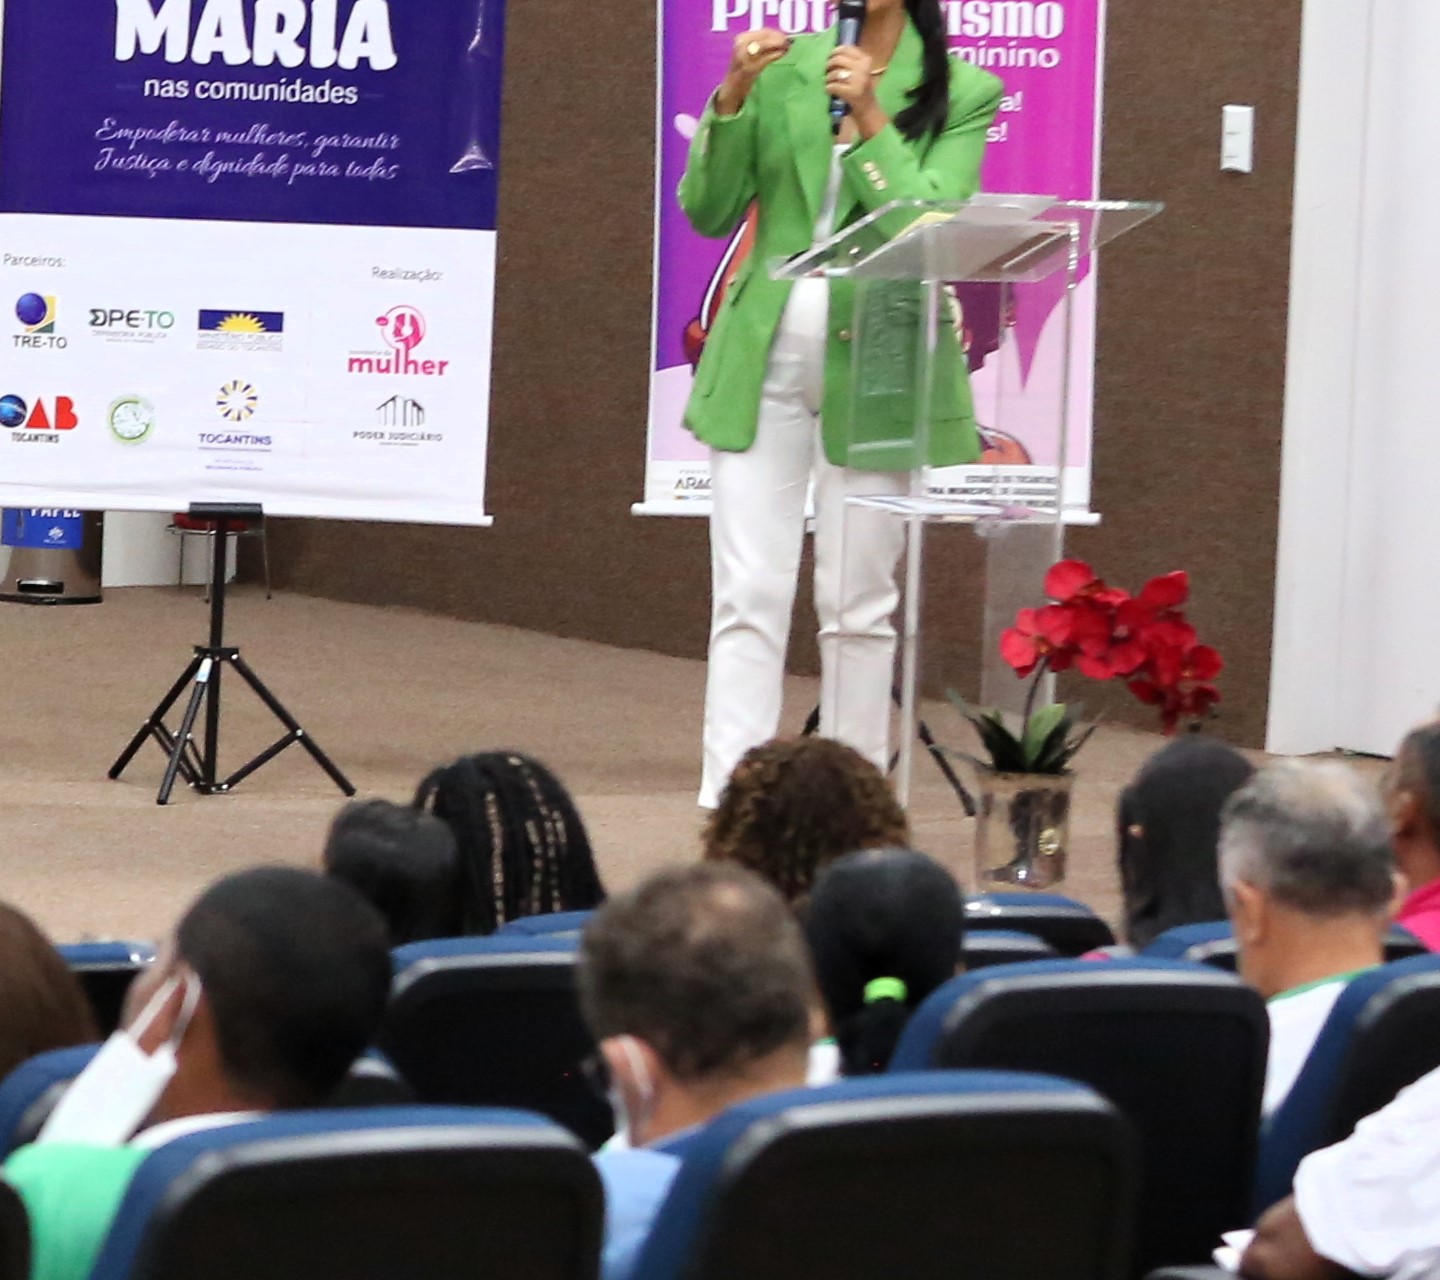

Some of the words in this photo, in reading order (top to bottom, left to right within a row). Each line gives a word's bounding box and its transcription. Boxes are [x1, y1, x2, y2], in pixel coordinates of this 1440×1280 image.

[143, 78, 190, 98] nas
[194, 77, 359, 105] comunidades
[94, 147, 173, 179] Justiça
[192, 151, 289, 183] dignidade
[288, 161, 340, 185] para
[3, 253, 66, 268] Parceiros:
[372, 266, 443, 283] Realização:
[12, 334, 68, 350] TRE-TO
[348, 347, 449, 376] mulher
[198, 432, 273, 446] TOCANTINS
